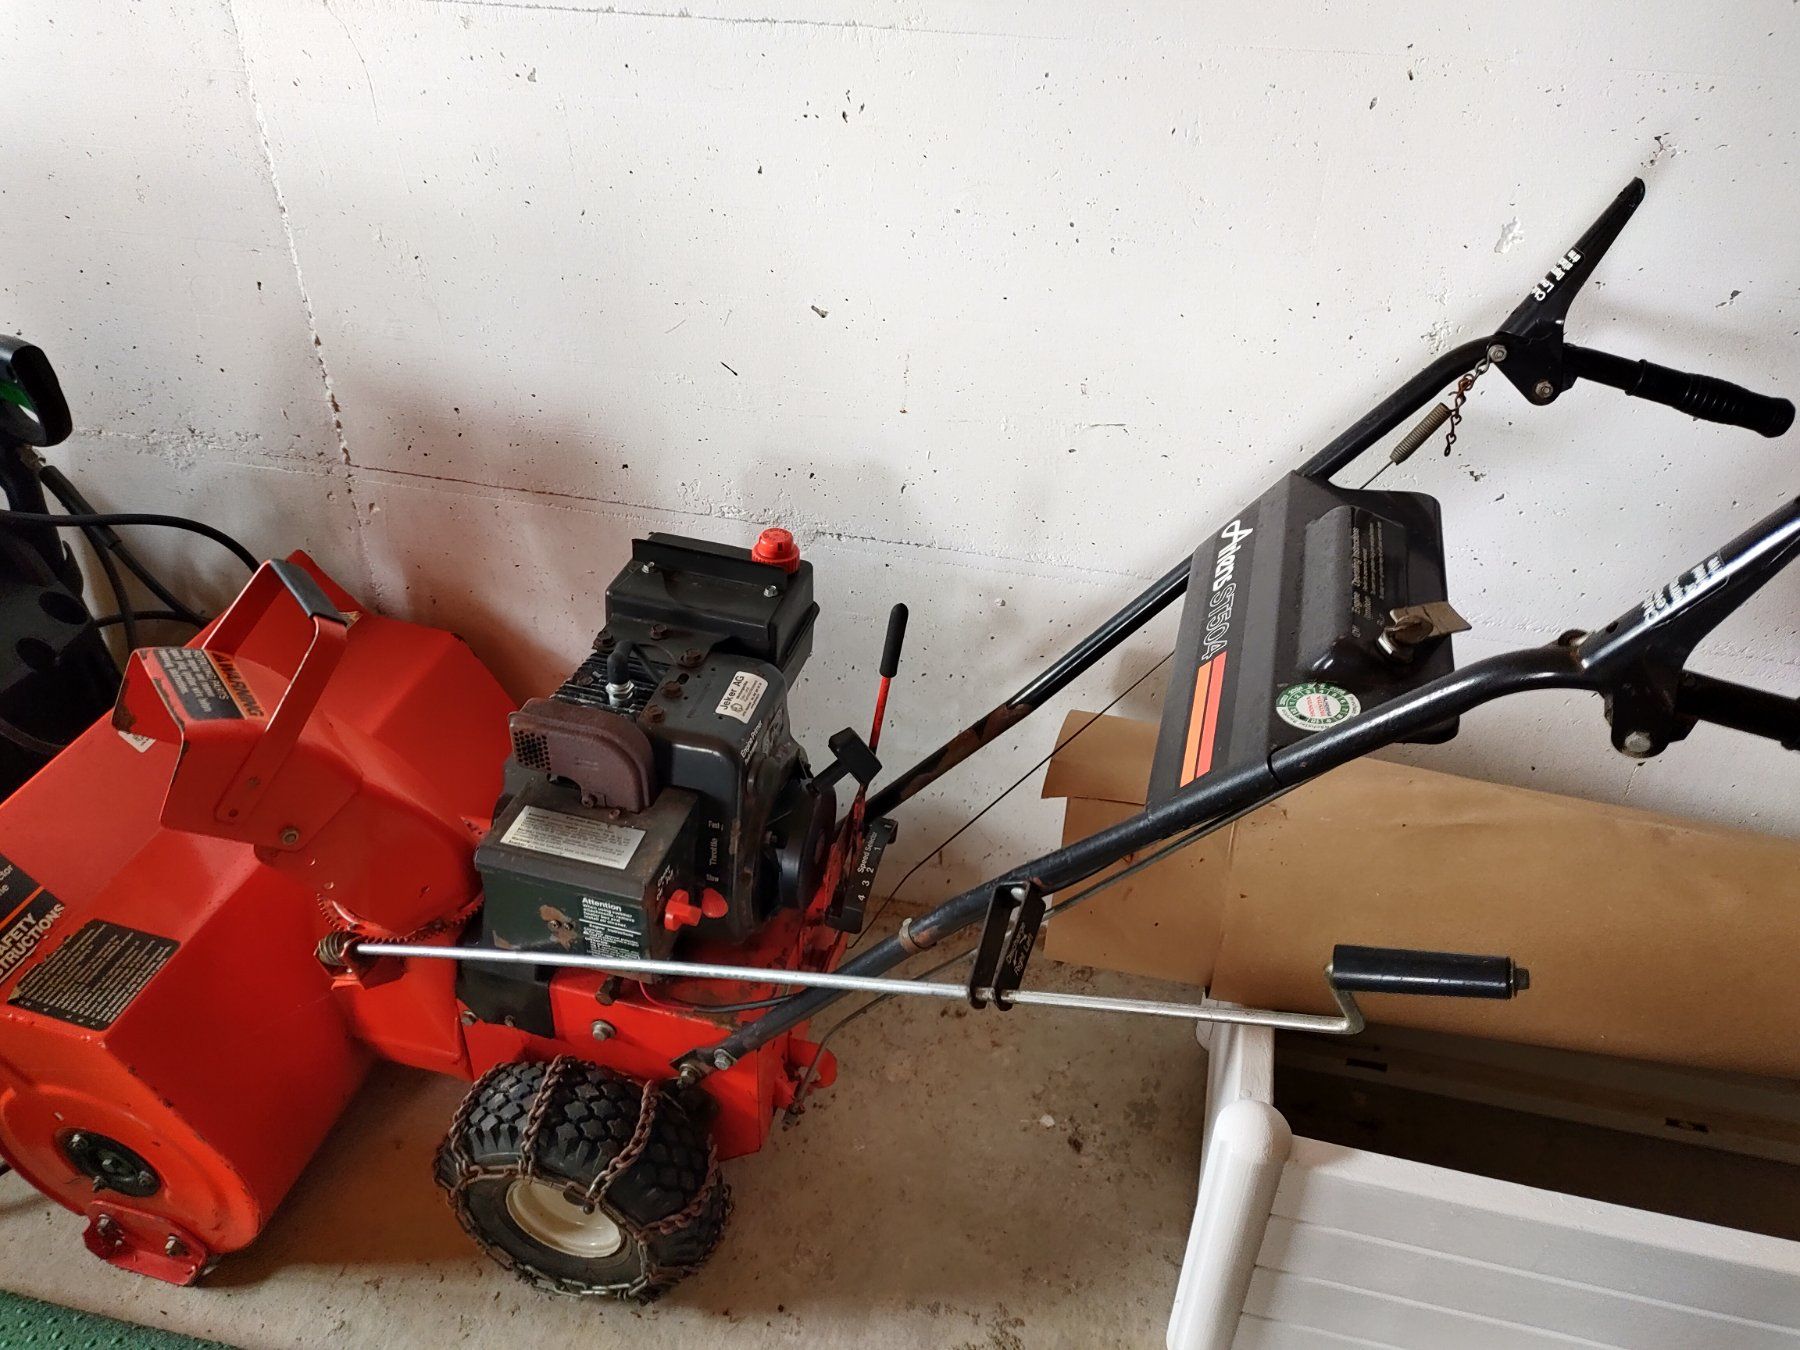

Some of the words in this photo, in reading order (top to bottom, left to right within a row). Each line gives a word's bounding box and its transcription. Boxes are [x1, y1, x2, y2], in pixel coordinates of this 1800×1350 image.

[719, 689, 737, 711] Jeker
[733, 675, 745, 688] AG
[857, 851, 870, 874] Speed
[866, 866, 875, 874] 2
[582, 897, 622, 912] Attention
[857, 893, 866, 901] 4
